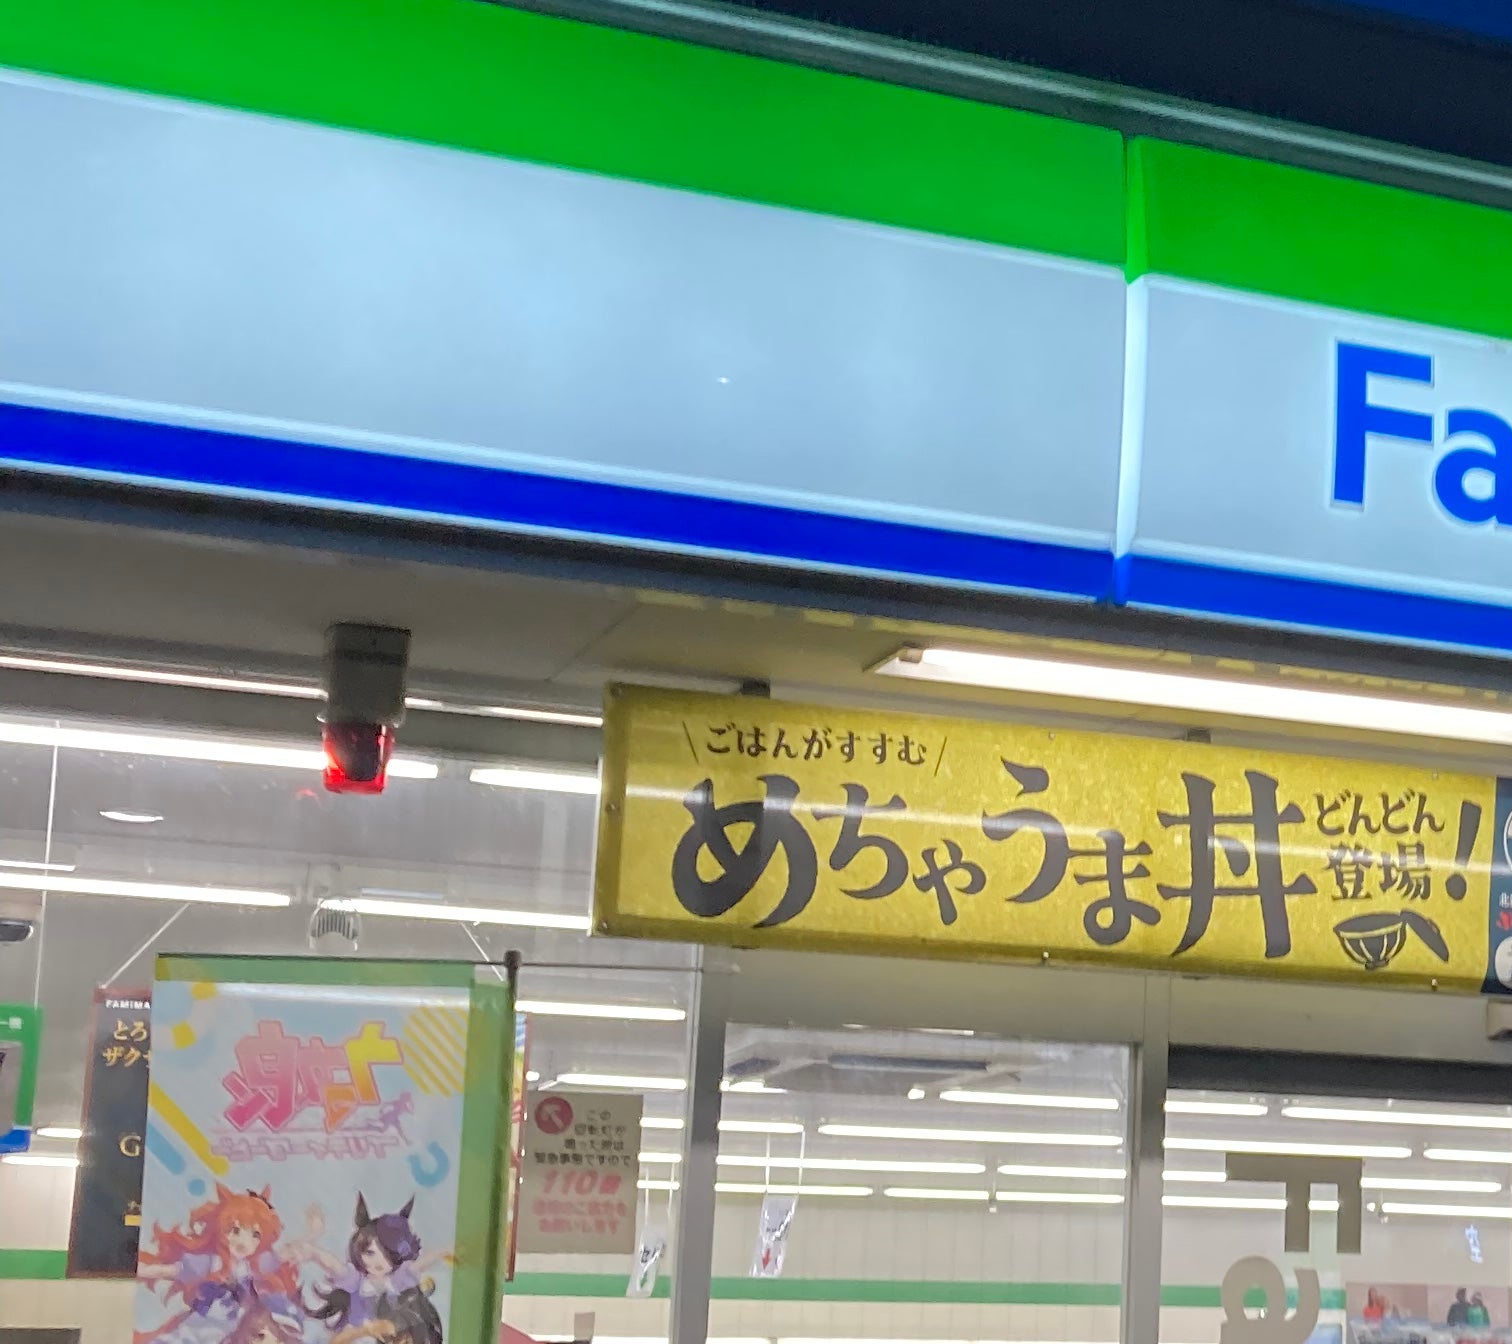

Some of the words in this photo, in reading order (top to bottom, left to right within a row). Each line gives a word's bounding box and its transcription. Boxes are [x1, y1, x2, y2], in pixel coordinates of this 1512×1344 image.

[706, 722, 927, 765] ごはんがすすむ
[1314, 788, 1445, 836] どんどん
[672, 757, 1317, 959] めちゃうま丼
